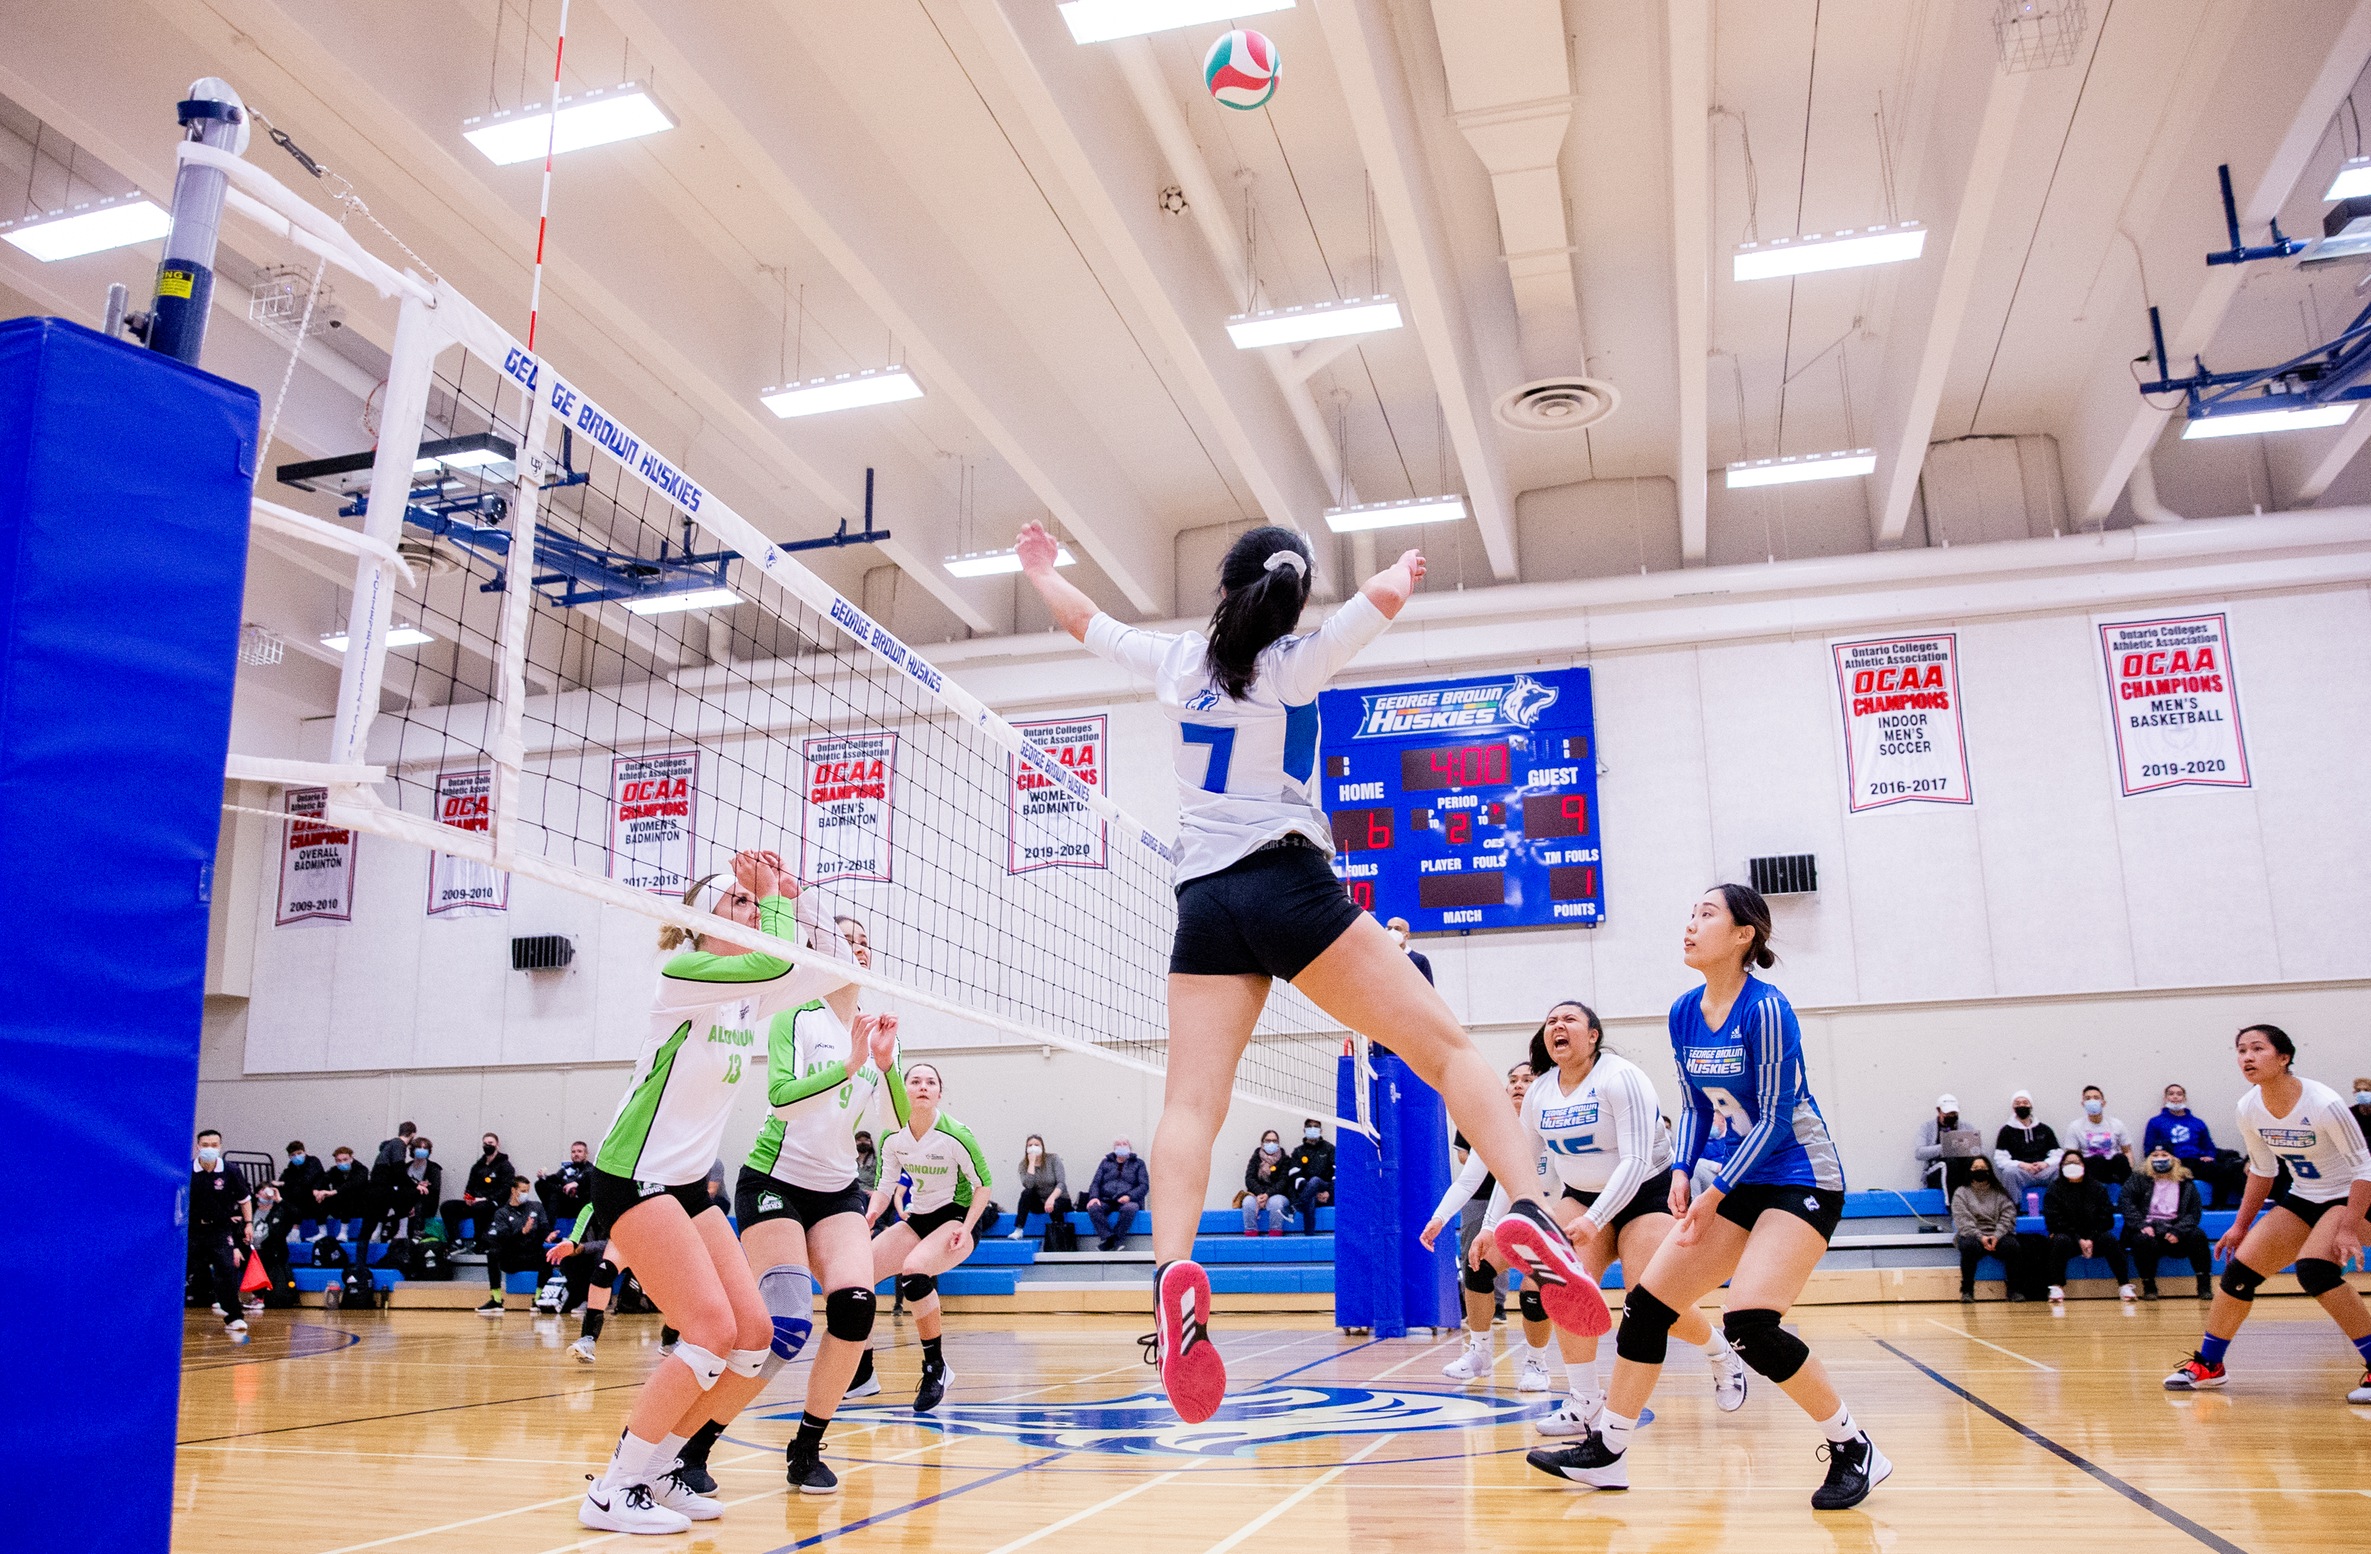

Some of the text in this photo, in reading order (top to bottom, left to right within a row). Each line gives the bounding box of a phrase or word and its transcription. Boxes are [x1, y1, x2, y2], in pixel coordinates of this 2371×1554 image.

[504, 347, 702, 512] GEOGE BROWN HUSKIES
[2119, 624, 2207, 640] Ontario Colleges
[830, 597, 942, 693] GEORGE BROWN HUSKIES
[1852, 642, 1938, 657] Ontario Colleges
[2113, 634, 2218, 651] Athletic Association
[1845, 652, 1948, 669] Athletic Association
[2122, 647, 2216, 678] OCAA
[1854, 664, 1944, 694] OCAA
[2120, 674, 2223, 700] CHAMPIONS
[1375, 687, 1503, 711] GEORGE BROWN
[1853, 691, 1949, 717] CHAMPIONS
[2151, 697, 2198, 712] MEN'S
[1367, 708, 1497, 733] HUSKIES
[1878, 714, 1927, 728] INDOOR
[2130, 709, 2224, 728] BASKETBALL
[1023, 725, 1092, 737] Ontario Colleges
[1050, 732, 1099, 745] Association
[1884, 728, 1924, 741] MEN'S
[817, 739, 883, 752] Ontario Colleges
[1880, 741, 1931, 755] SOCCER
[810, 748, 889, 762] Athletic Association
[1020, 740, 1045, 769] GEORGE
[1179, 721, 1238, 794] 7
[625, 759, 687, 771] Ontario Colleges
[814, 760, 884, 785] OCAA
[1430, 745, 1507, 785] 4:00
[2142, 759, 2226, 777] 2019-2020
[619, 767, 692, 780] Athletic Association
[1528, 767, 1578, 787] GUEST
[448, 777, 473, 787] Ontario
[1870, 778, 1947, 795] 2016-2017
[442, 787, 468, 796] Athletic
[622, 778, 687, 803] OCAA
[811, 783, 885, 805] CHAMPIONS
[1029, 789, 1074, 803] WOME
[1339, 782, 1385, 801] HOME
[444, 795, 488, 818] OCA
[831, 802, 864, 815] MEN'S
[1023, 801, 1090, 815] BADMINTO
[1437, 795, 1478, 809] PERIOD
[1481, 805, 1488, 814] P
[620, 801, 688, 822] CHAMPIONS
[1428, 809, 1434, 818] P
[1562, 795, 1584, 833] 9
[630, 819, 677, 833] WOMEN'S
[819, 814, 876, 828] BADMINTON
[1429, 819, 1439, 829] TO
[1477, 815, 1489, 825] TO
[1368, 812, 1390, 849] 6
[1450, 813, 1467, 843] 2
[290, 830, 349, 850] CHAMPIONS
[625, 831, 680, 844] BADMINTON
[299, 847, 338, 860] OVERALL
[1025, 844, 1090, 858] 2019-2020
[1544, 849, 1599, 864] TM FOULS
[294, 857, 342, 871] BADMINTON
[816, 859, 876, 873] 2017-2018
[1347, 863, 1379, 878] FOULS
[1420, 855, 1507, 873] PLAYER FOULS
[1585, 869, 1592, 895] 1
[442, 887, 492, 900] 2009-2010
[290, 898, 338, 912] 2009-2010
[1553, 903, 1596, 917] POINTS
[1443, 910, 1482, 924] MATCH
[721, 1054, 742, 1084] 13
[1686, 1058, 1741, 1074] HUSKIES
[839, 1083, 853, 1109] 9
[1541, 1114, 1597, 1128] HUSKIES
[2263, 1135, 2315, 1147] HUSKIES
[915, 1178, 925, 1193] 2
